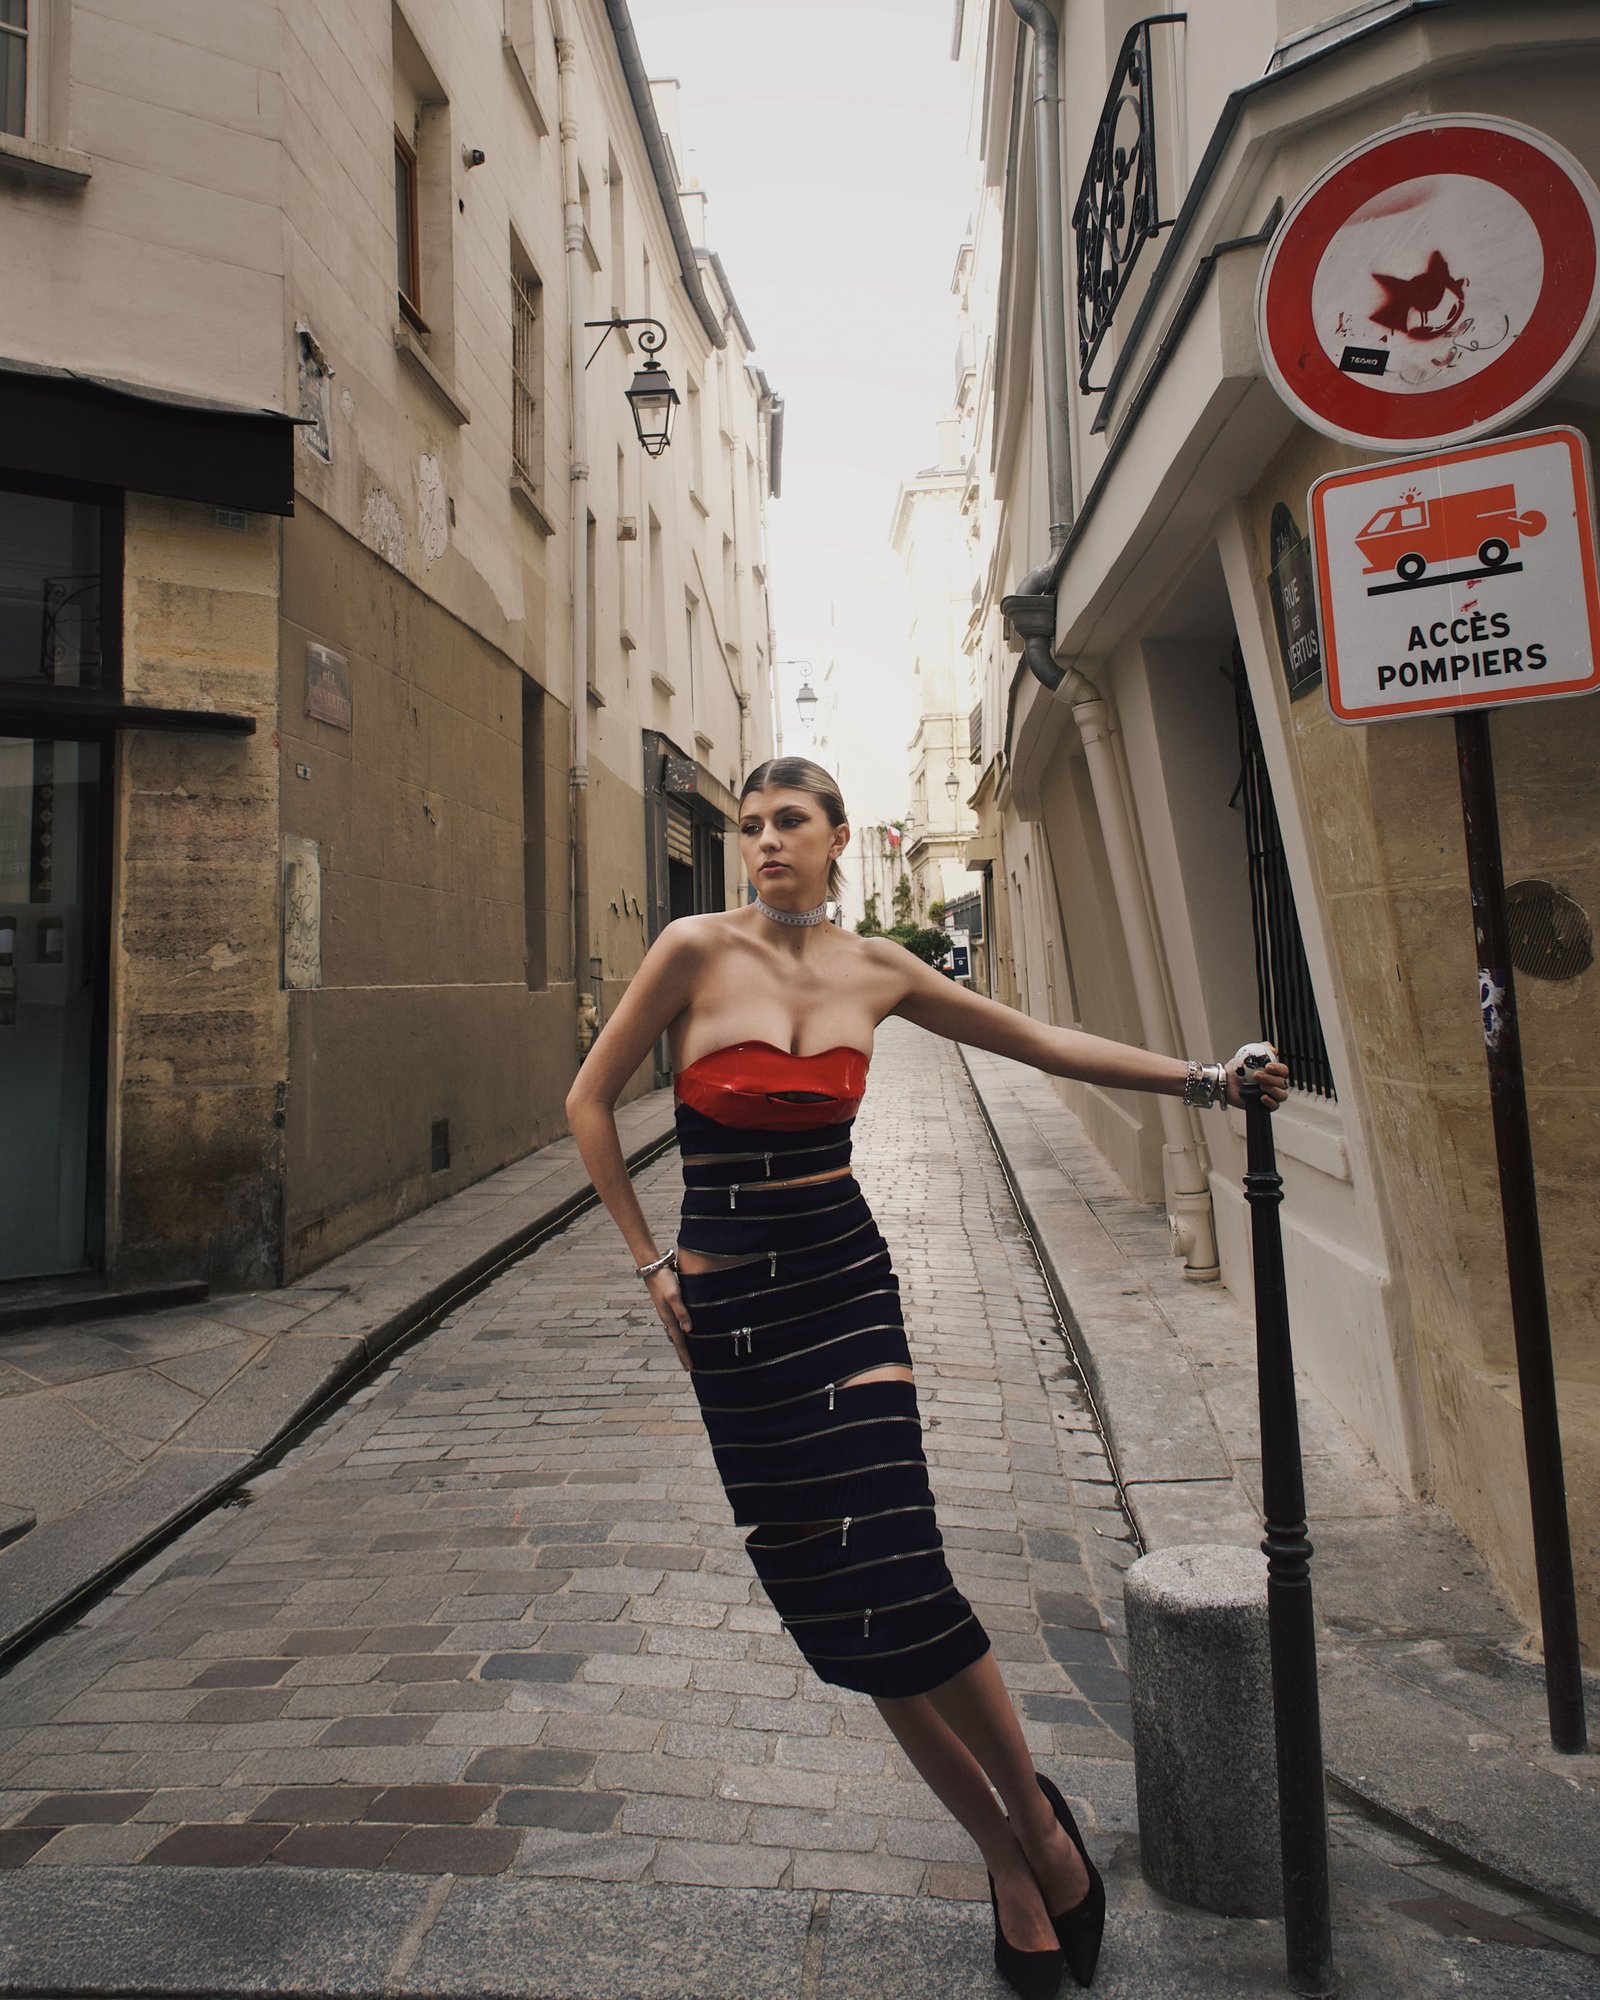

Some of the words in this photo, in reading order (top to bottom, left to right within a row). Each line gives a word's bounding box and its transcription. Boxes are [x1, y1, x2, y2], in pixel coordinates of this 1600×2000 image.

[1284, 577, 1300, 611] RUE
[1288, 629, 1318, 671] VERTUS
[1408, 611, 1510, 651] ACCÈS
[1377, 643, 1547, 690] POMPIERS
